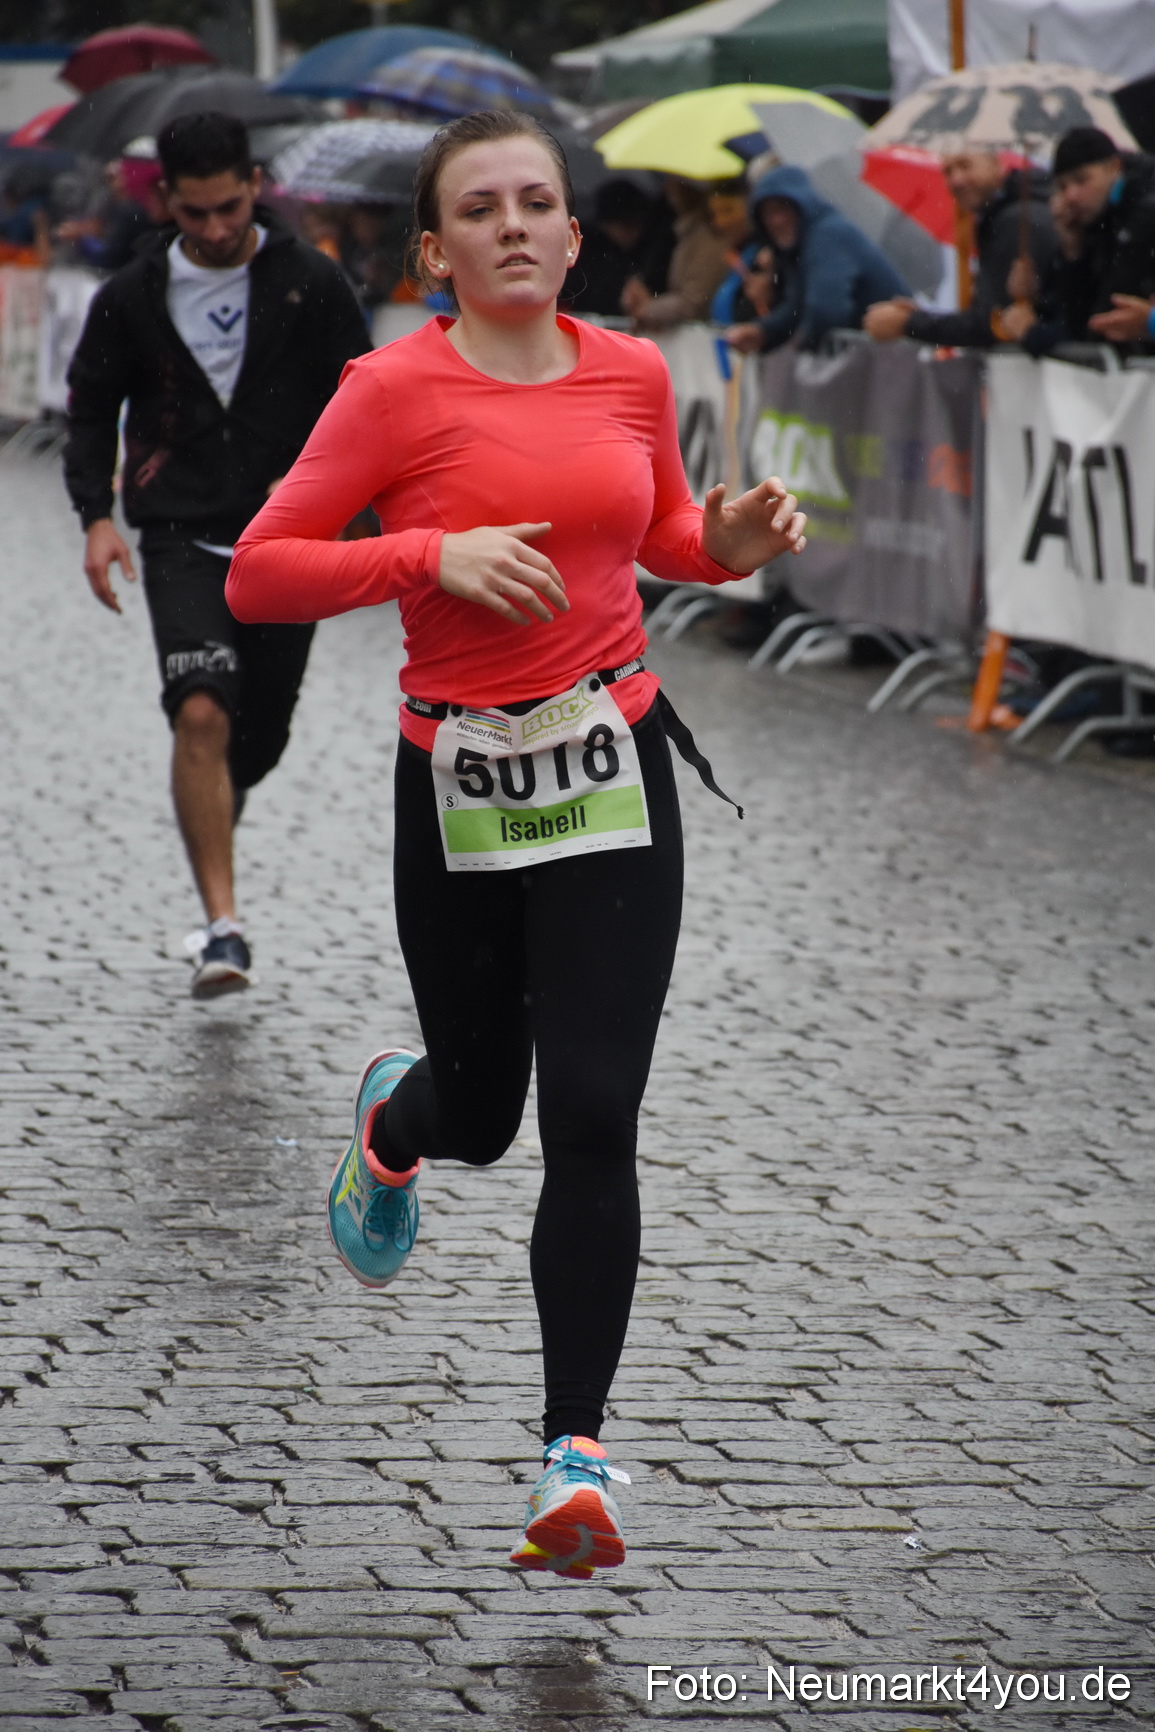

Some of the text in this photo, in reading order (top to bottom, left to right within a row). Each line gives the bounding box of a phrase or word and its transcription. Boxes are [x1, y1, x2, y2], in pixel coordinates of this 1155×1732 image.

[457, 721, 513, 746] NeuerMarkt
[522, 686, 594, 740] BOCK
[454, 723, 620, 801] 5018
[500, 804, 587, 843] Isabell
